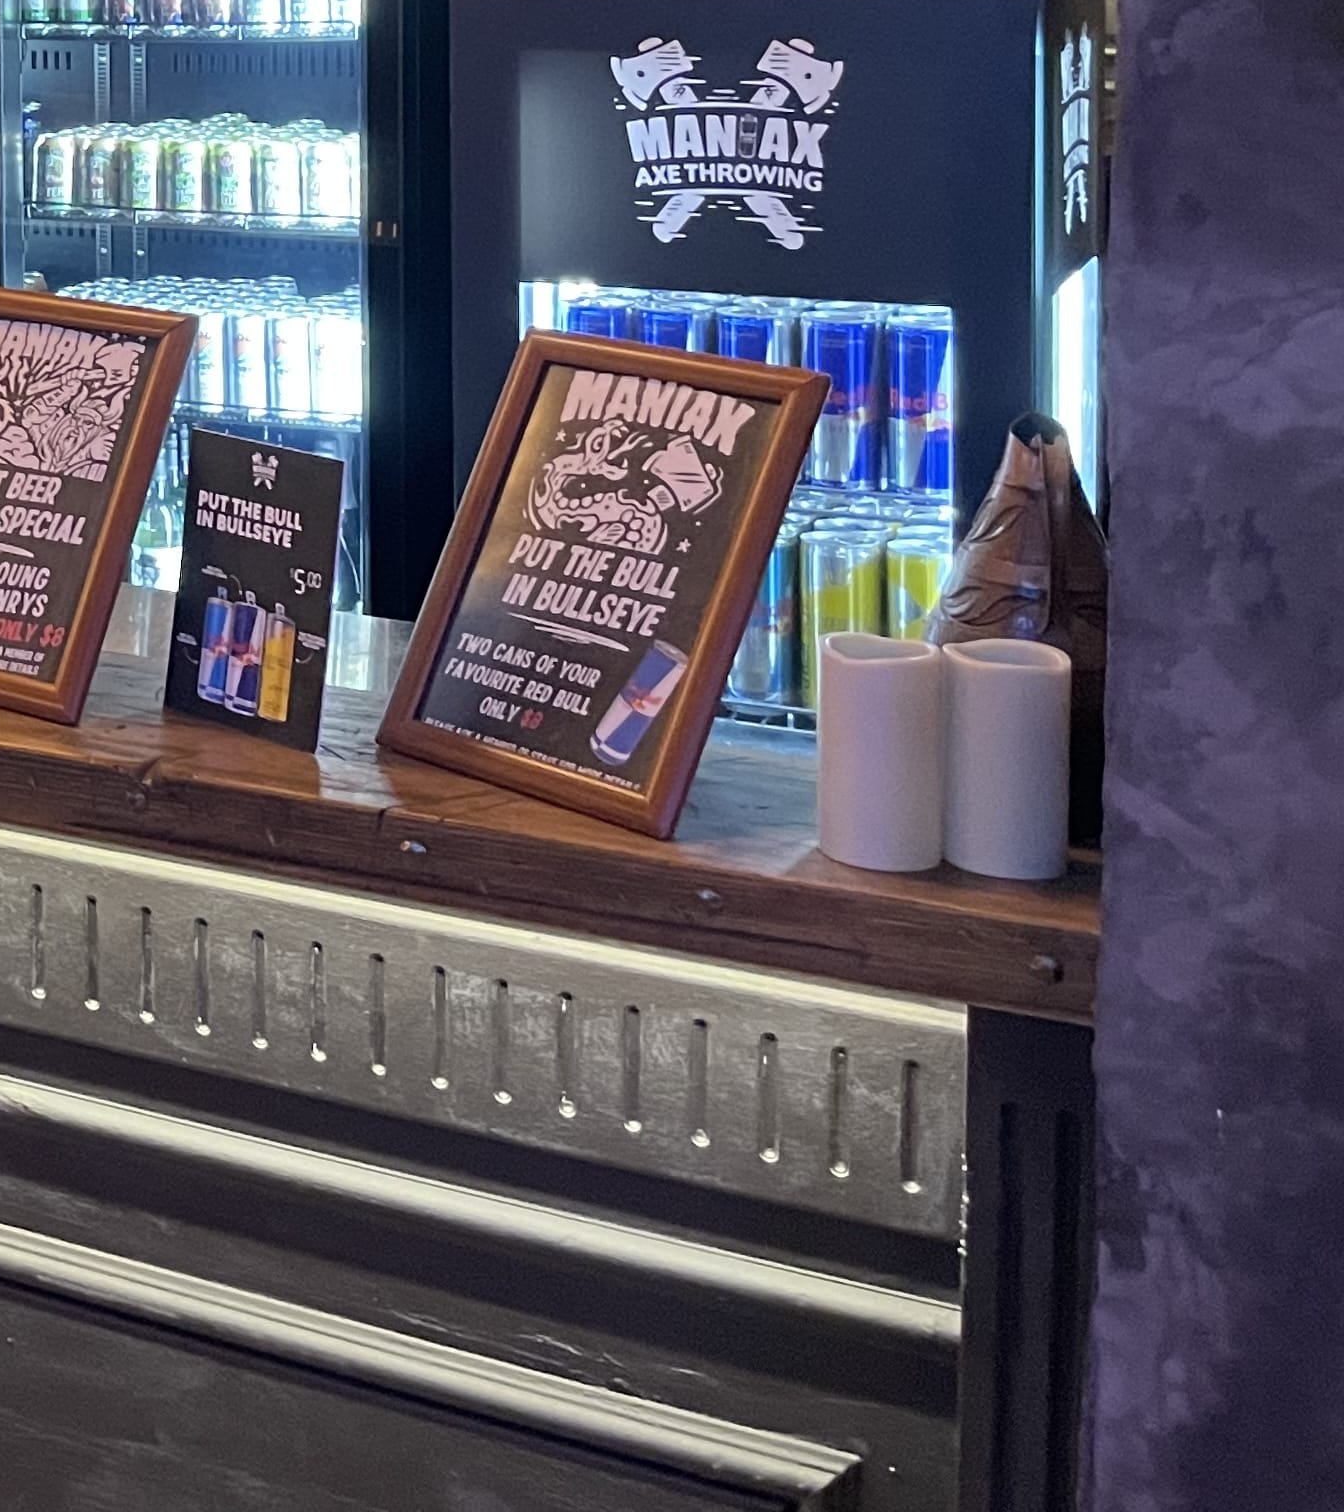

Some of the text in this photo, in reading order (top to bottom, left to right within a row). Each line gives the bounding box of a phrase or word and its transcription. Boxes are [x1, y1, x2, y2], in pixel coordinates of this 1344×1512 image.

[634, 163, 824, 192] AXE THROWING
[559, 370, 757, 457] MANIAX
[5, 472, 62, 505] BEER
[196, 509, 293, 549] IN BULLSEYE
[198, 489, 303, 532] PUT THE BULL
[507, 534, 680, 600] PUT THE BULL
[501, 573, 667, 637] IN BULLSEYE
[3, 647, 34, 661] MEMBER
[33, 652, 45, 662] OF
[39, 623, 65, 647] $8
[8, 661, 40, 676] DETAILS
[456, 633, 602, 689] TWO CANS OF YOUR
[444, 658, 593, 716] FAVOURITE RED BULL
[479, 696, 522, 723] ONLY
